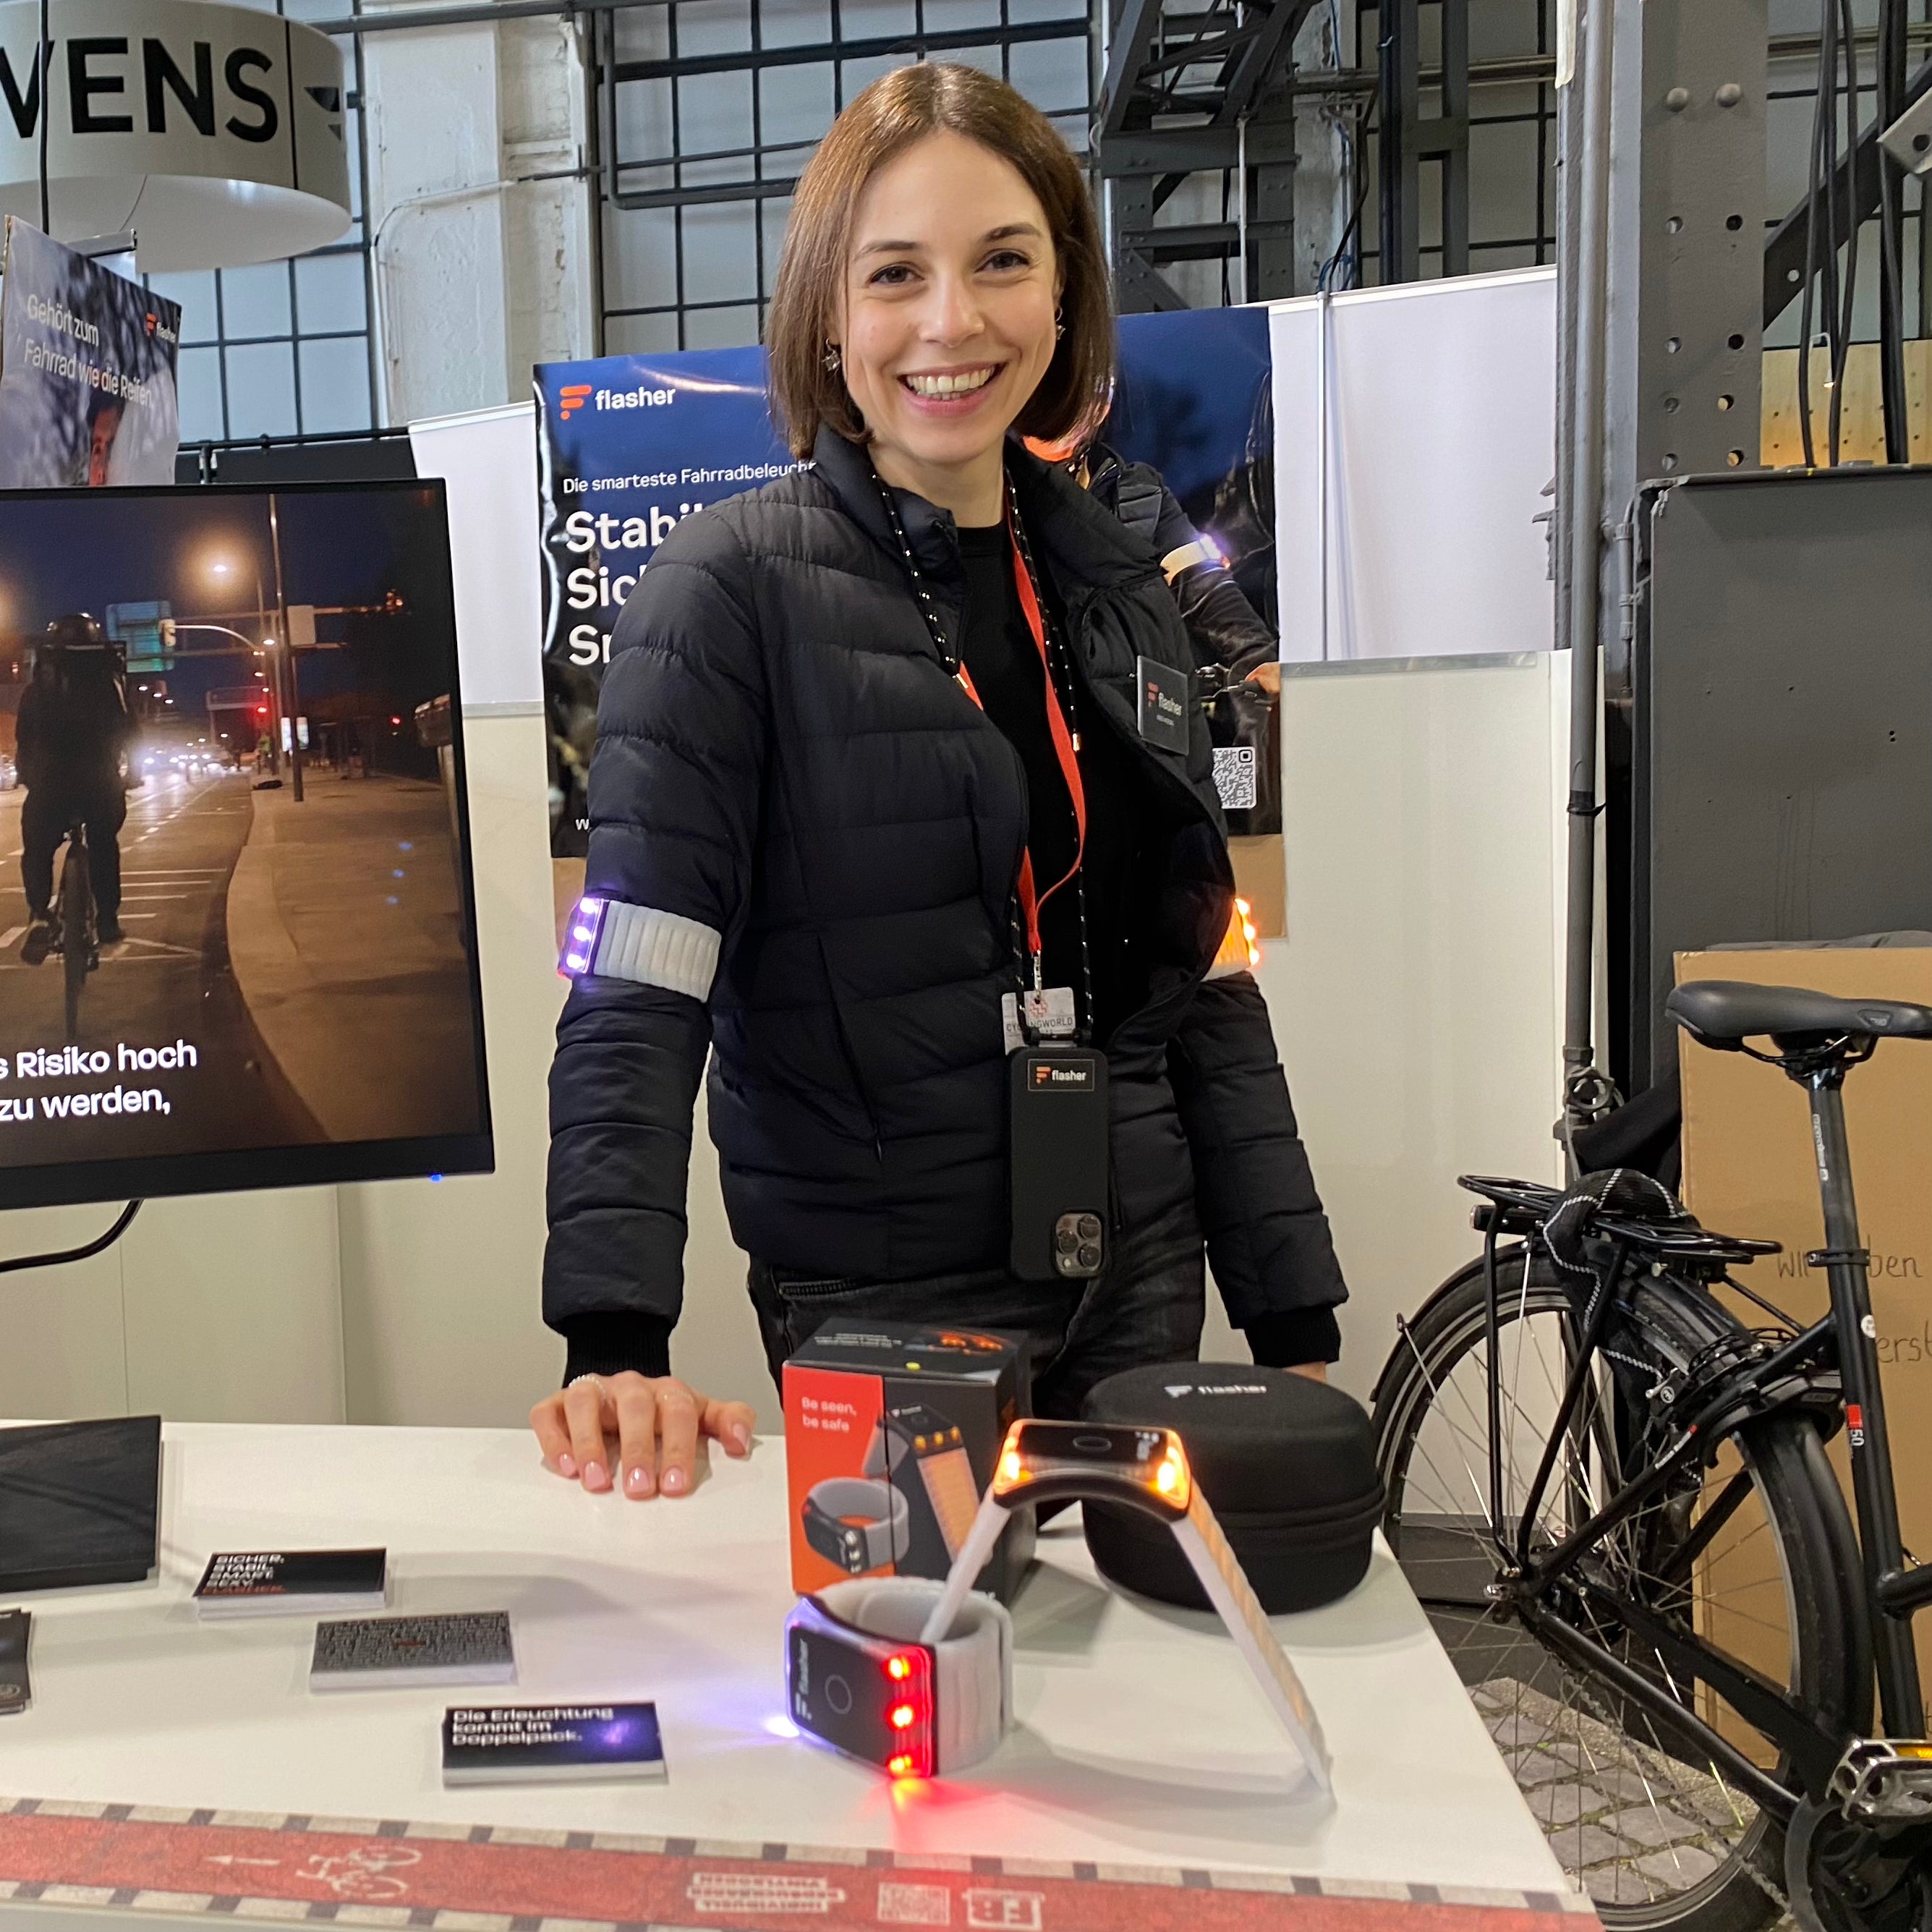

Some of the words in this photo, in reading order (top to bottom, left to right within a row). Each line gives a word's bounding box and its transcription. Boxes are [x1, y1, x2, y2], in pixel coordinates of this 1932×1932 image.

[27, 293, 73, 336] Gehört
[74, 317, 99, 347] zum
[24, 337, 77, 379] Fahrrad
[78, 359, 99, 388] wie
[101, 362, 119, 395] die
[595, 386, 676, 411] flasher
[563, 477, 589, 494] Die
[592, 471, 678, 492] smarteste
[1158, 691, 1182, 716] flasher
[17, 1046, 110, 1078] Risiko
[117, 1039, 197, 1072] hoch
[1052, 1069, 1086, 1081] flasher
[0, 1097, 34, 1121] zu
[41, 1084, 171, 1118] werden,
[801, 1396, 819, 1411] Be
[821, 1400, 857, 1416] seen,
[802, 1413, 819, 1429] be
[821, 1418, 850, 1432] safe
[454, 1710, 486, 1723] Die
[490, 1708, 613, 1722] Erleuchtung
[452, 1729, 583, 1747] Doppelpack.
[453, 1722, 522, 1734] kommt
[527, 1721, 551, 1732] im
